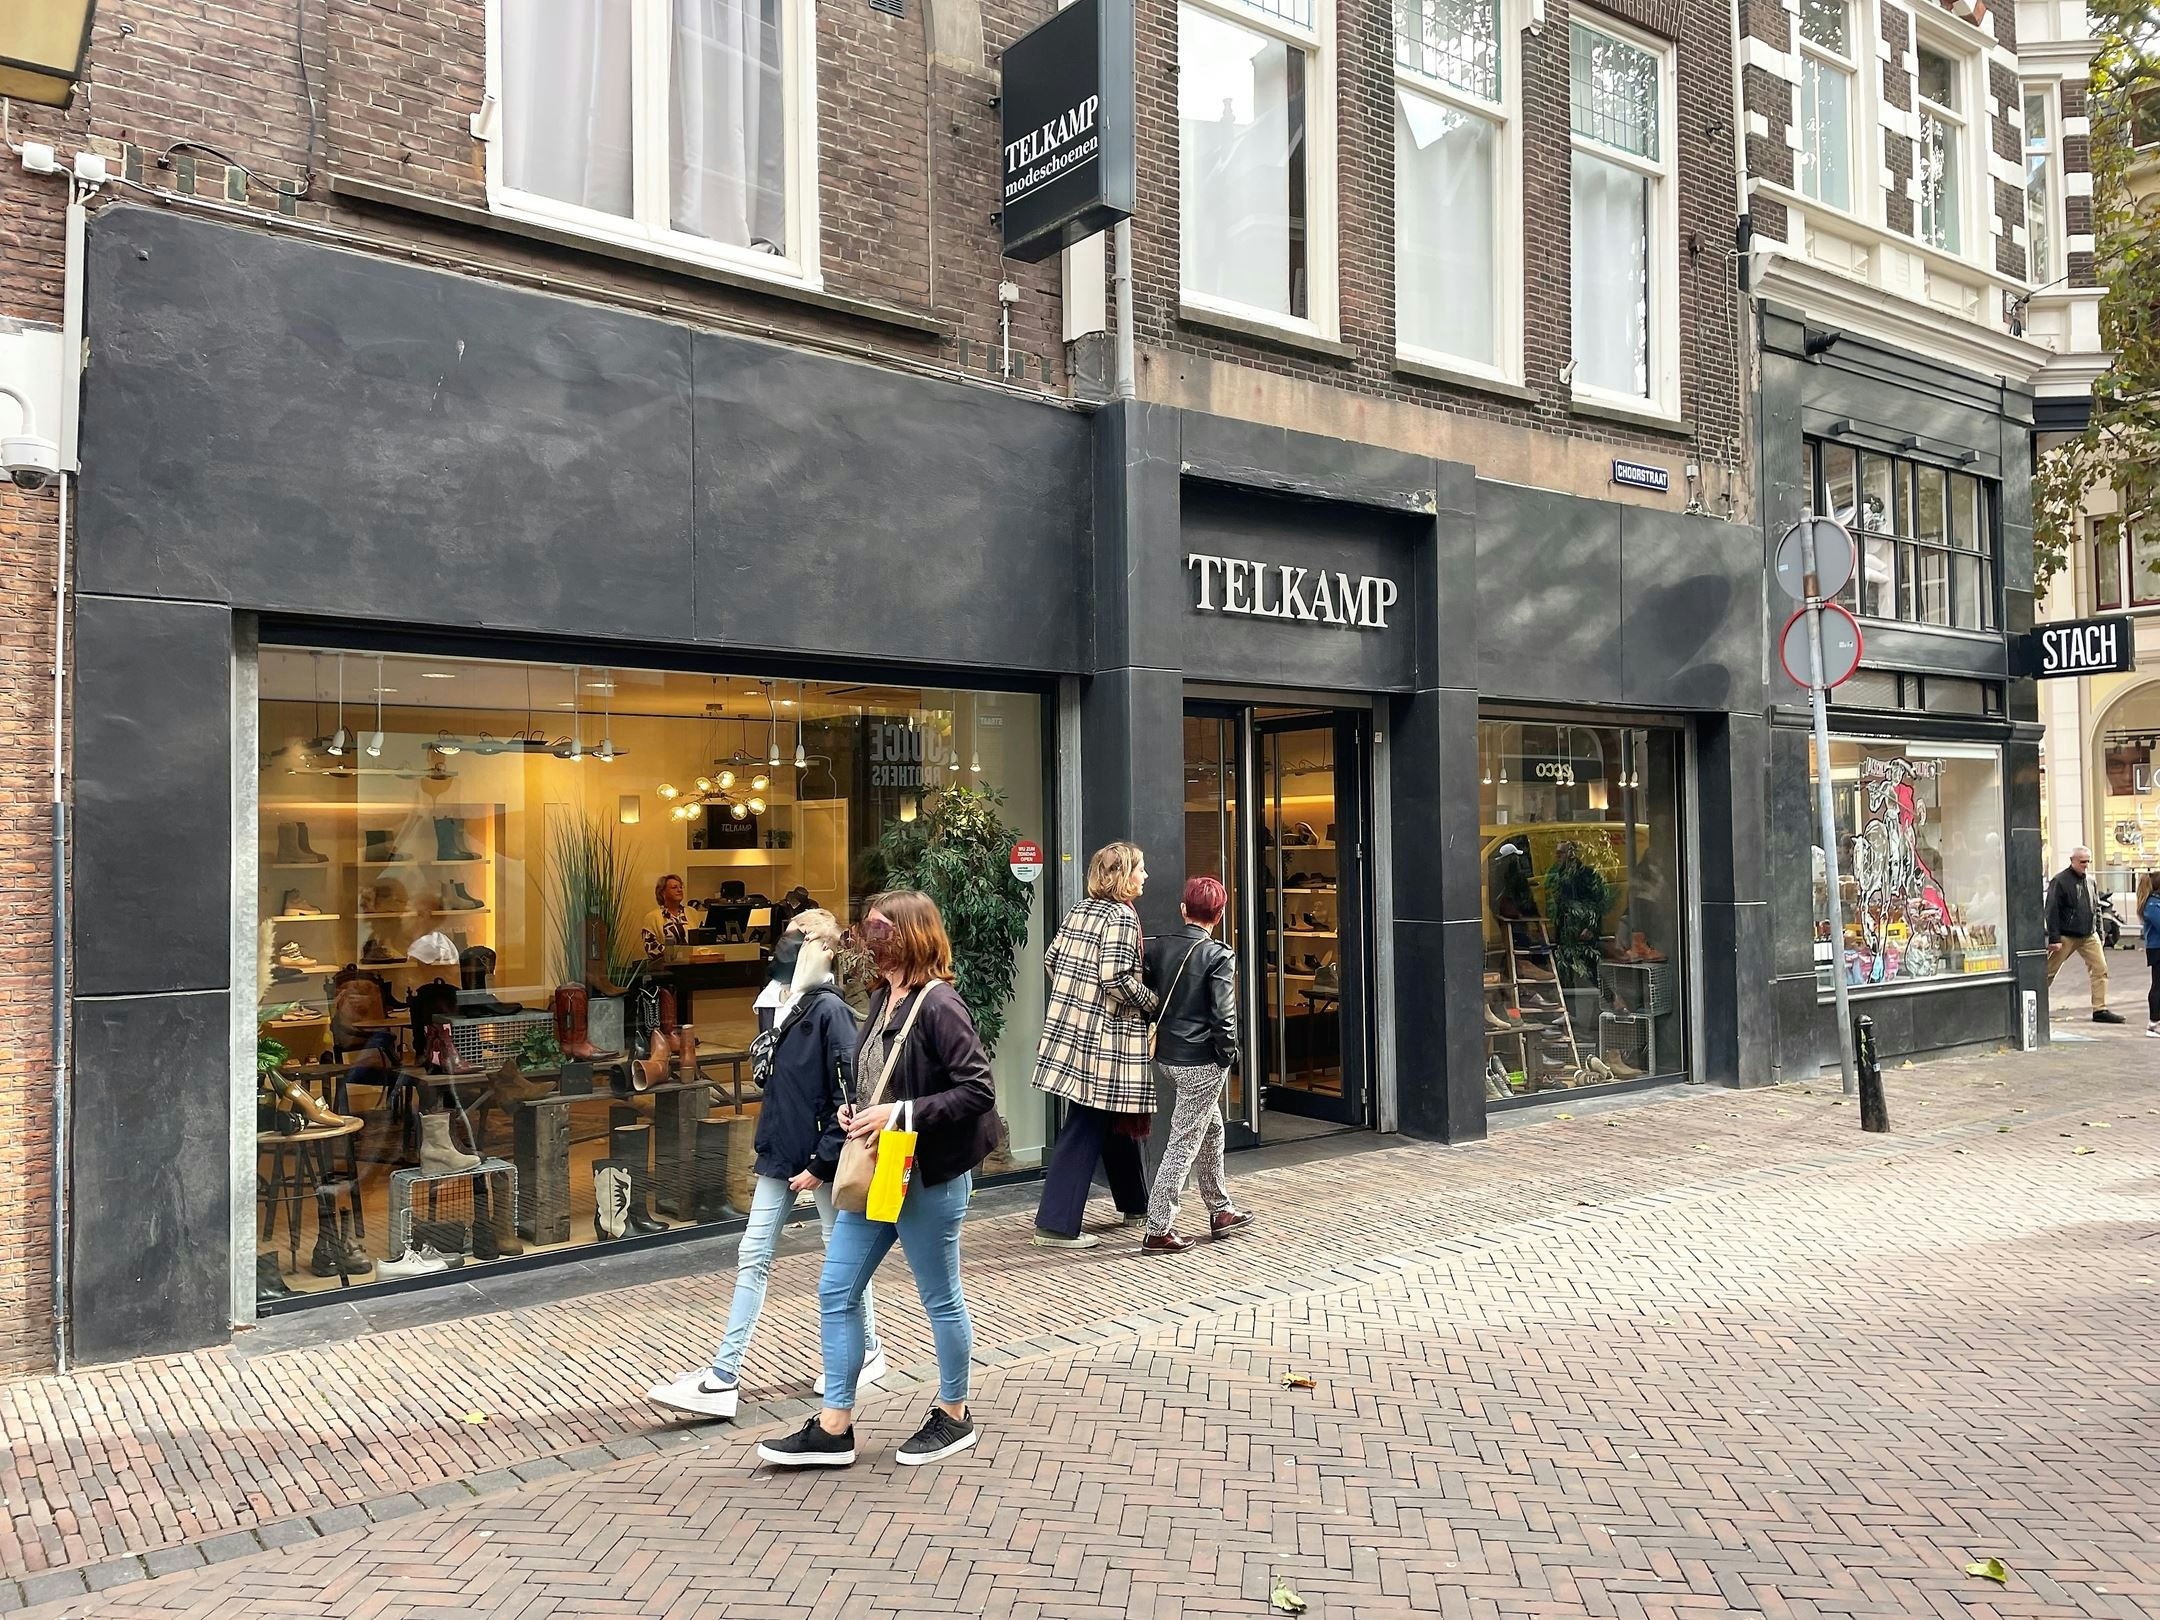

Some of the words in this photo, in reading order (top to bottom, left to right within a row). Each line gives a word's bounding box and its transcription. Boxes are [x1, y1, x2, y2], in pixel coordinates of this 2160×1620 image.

[1004, 94, 1099, 174] TELKAMP
[1005, 135, 1099, 198] modeschoenen
[1617, 464, 1667, 486] CHOORSTRAAT
[1188, 553, 1398, 628] TELKAMP
[2042, 624, 2117, 669] STACH
